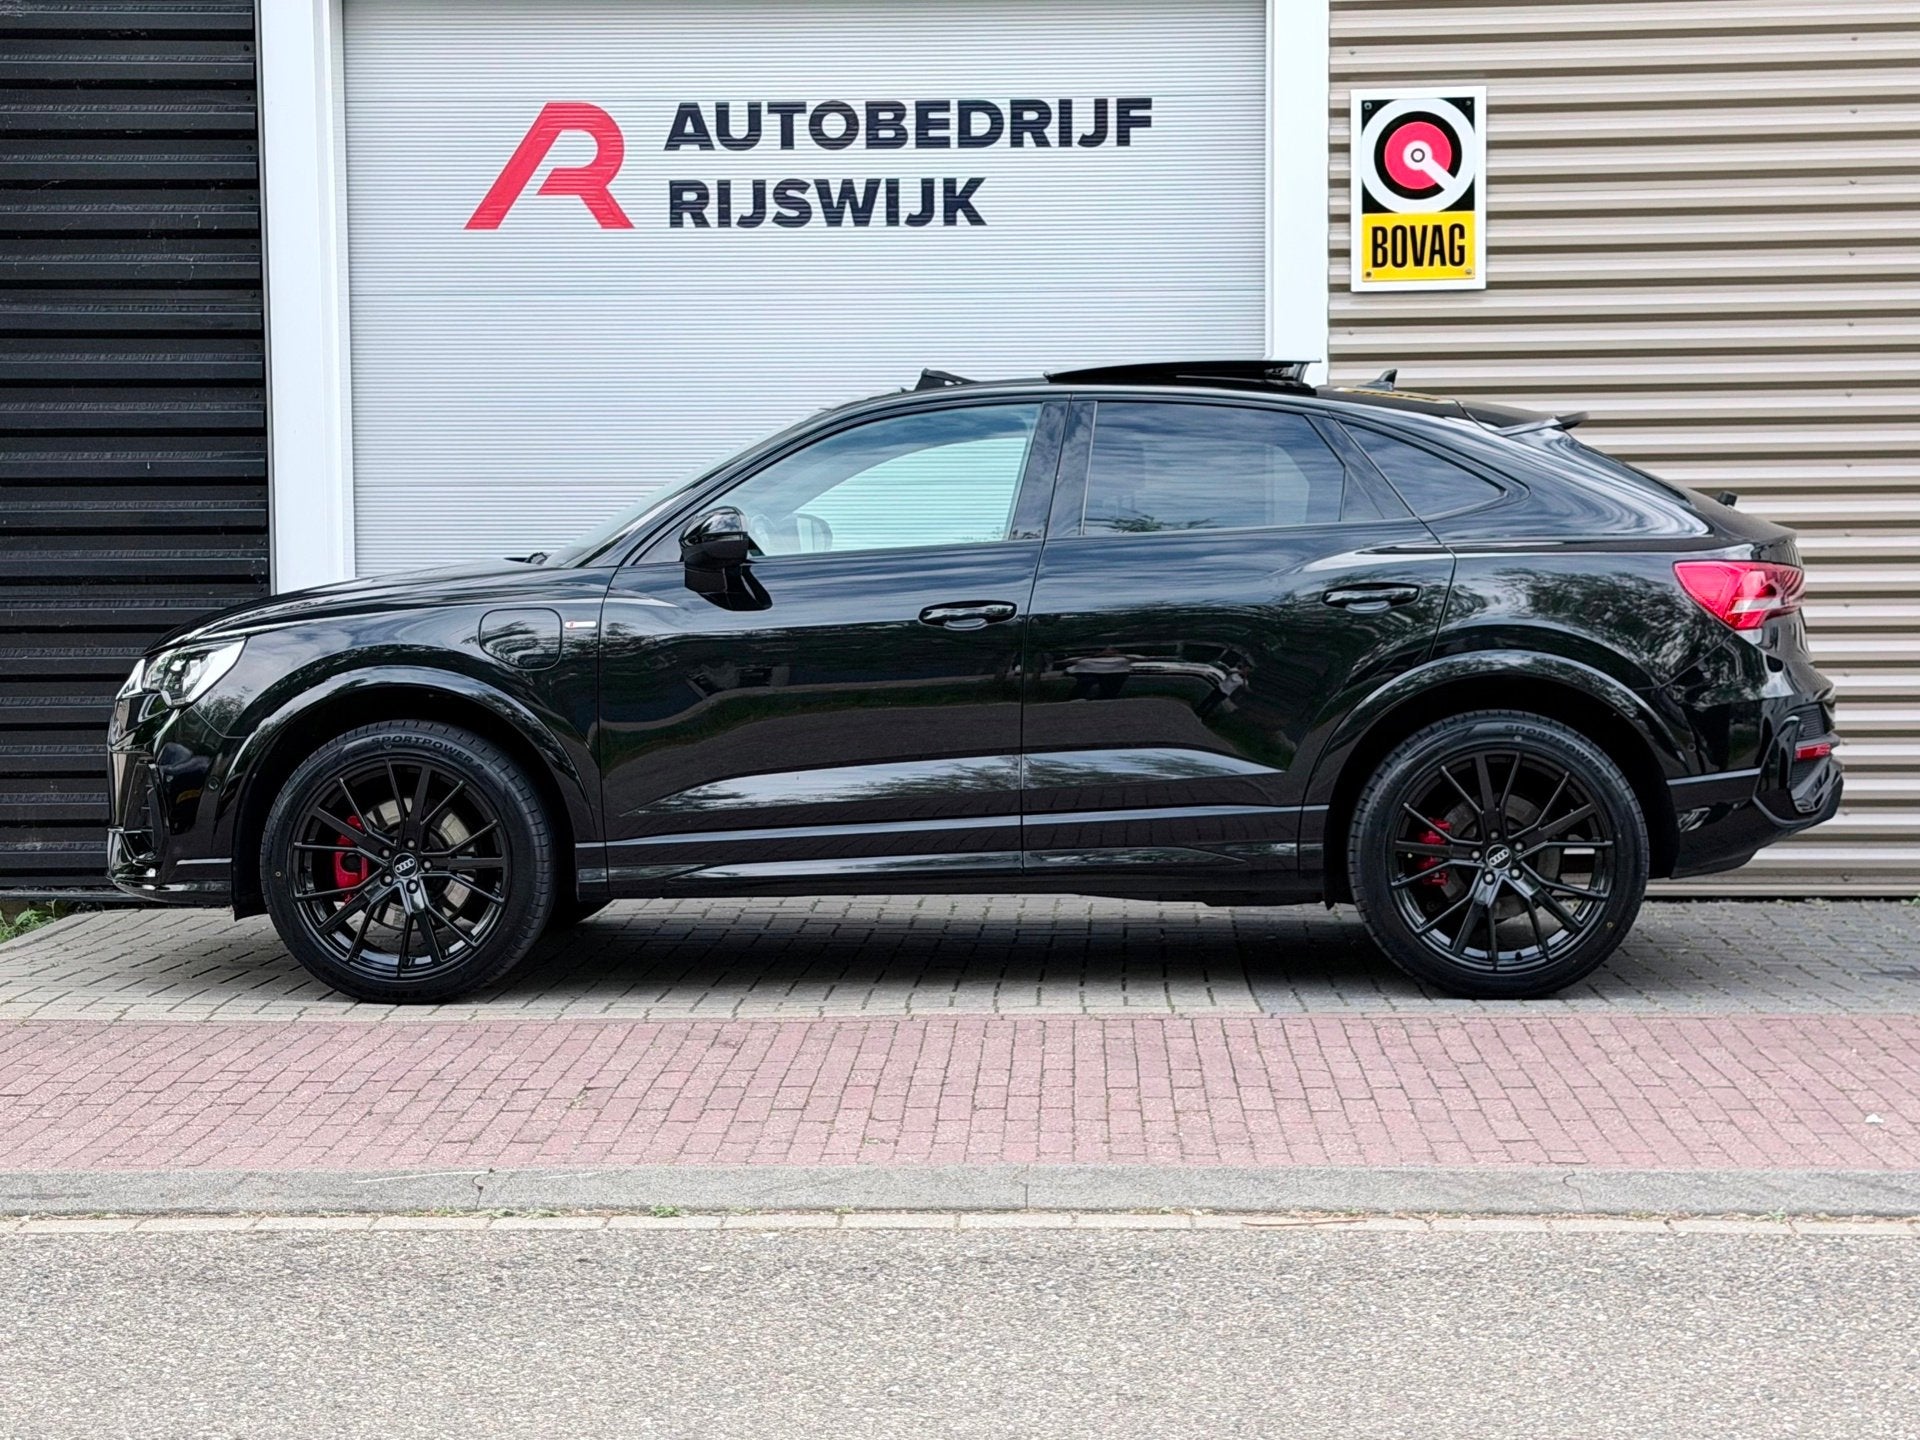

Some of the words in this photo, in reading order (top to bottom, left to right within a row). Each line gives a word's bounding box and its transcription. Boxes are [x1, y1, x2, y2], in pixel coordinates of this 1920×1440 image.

[664, 97, 1153, 151] AUTOBEDRIJF
[669, 177, 987, 229] RIJSWIJK
[1371, 223, 1466, 268] BOVAG
[371, 735, 474, 764] SPORTPOWER
